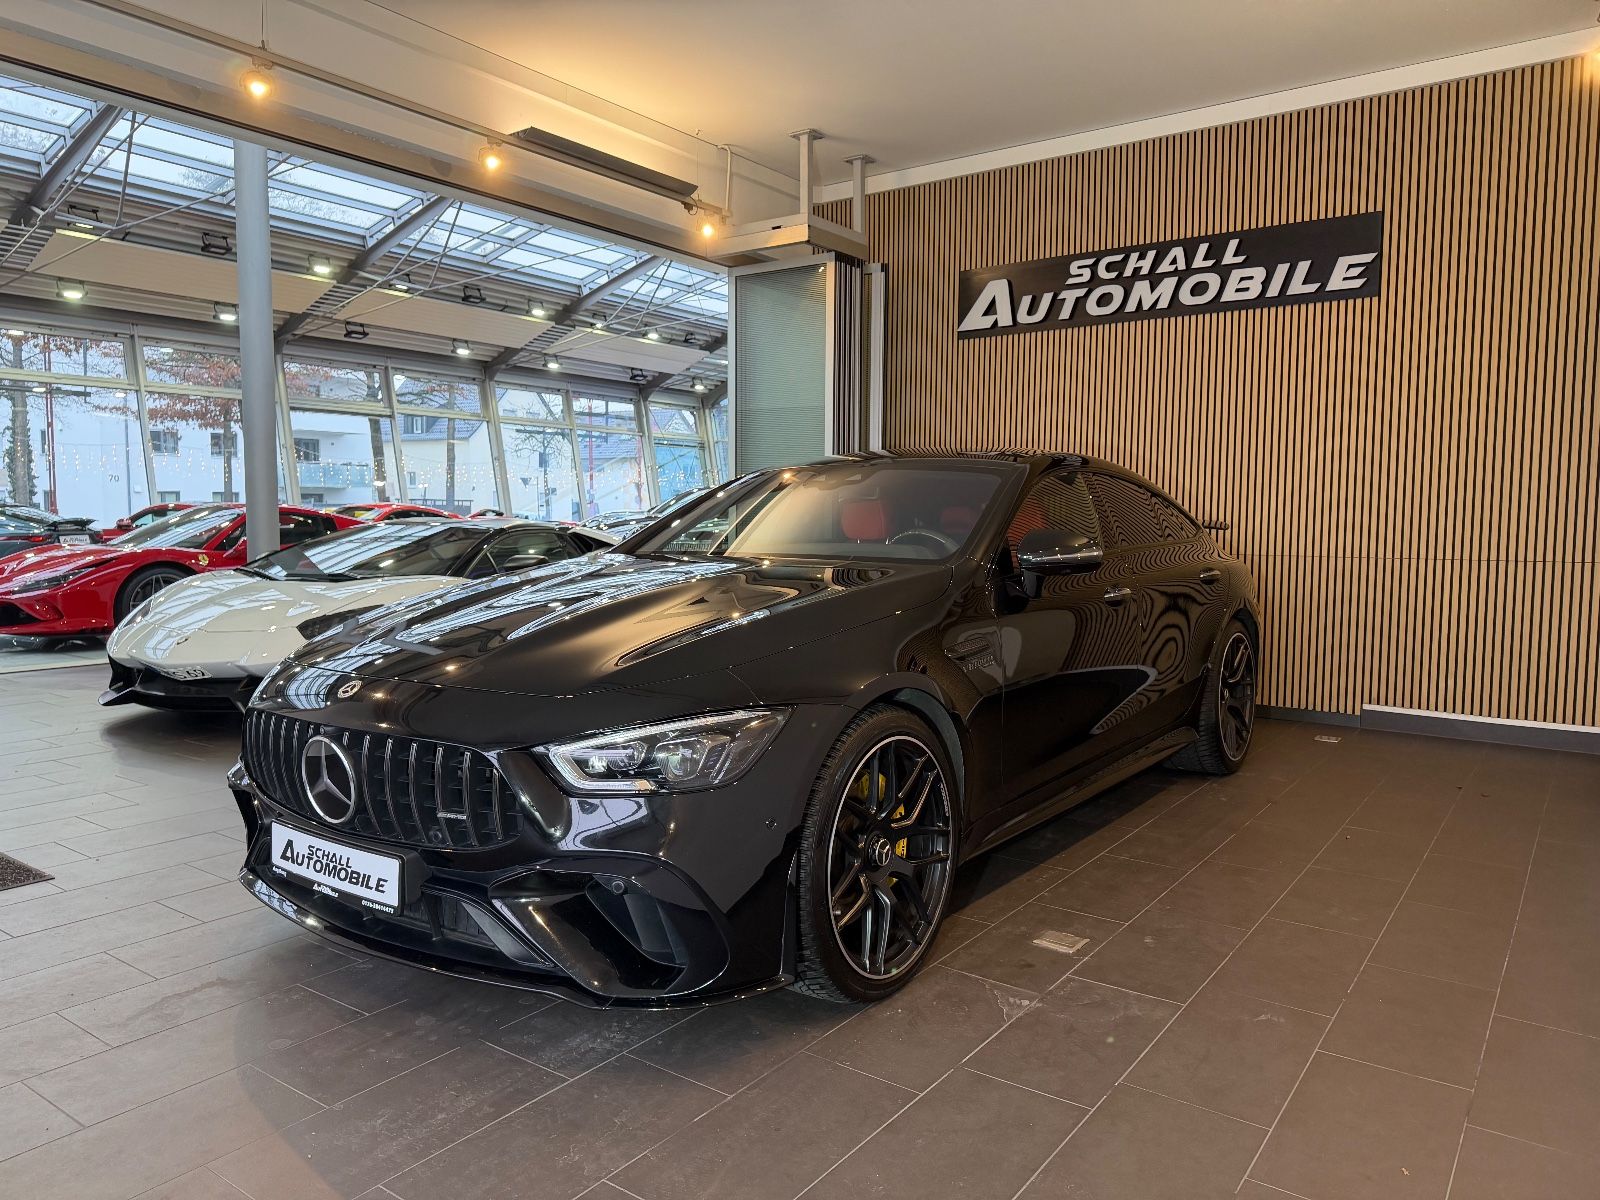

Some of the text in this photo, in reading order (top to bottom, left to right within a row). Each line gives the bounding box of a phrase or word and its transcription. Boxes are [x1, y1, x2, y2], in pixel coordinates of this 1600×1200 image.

[1064, 238, 1249, 286] SCHALL
[957, 251, 1379, 332] AUTOMOBILE
[108, 474, 120, 483] 70
[279, 838, 389, 894] AUTOMOBILE
[307, 844, 352, 869] SCHALL
